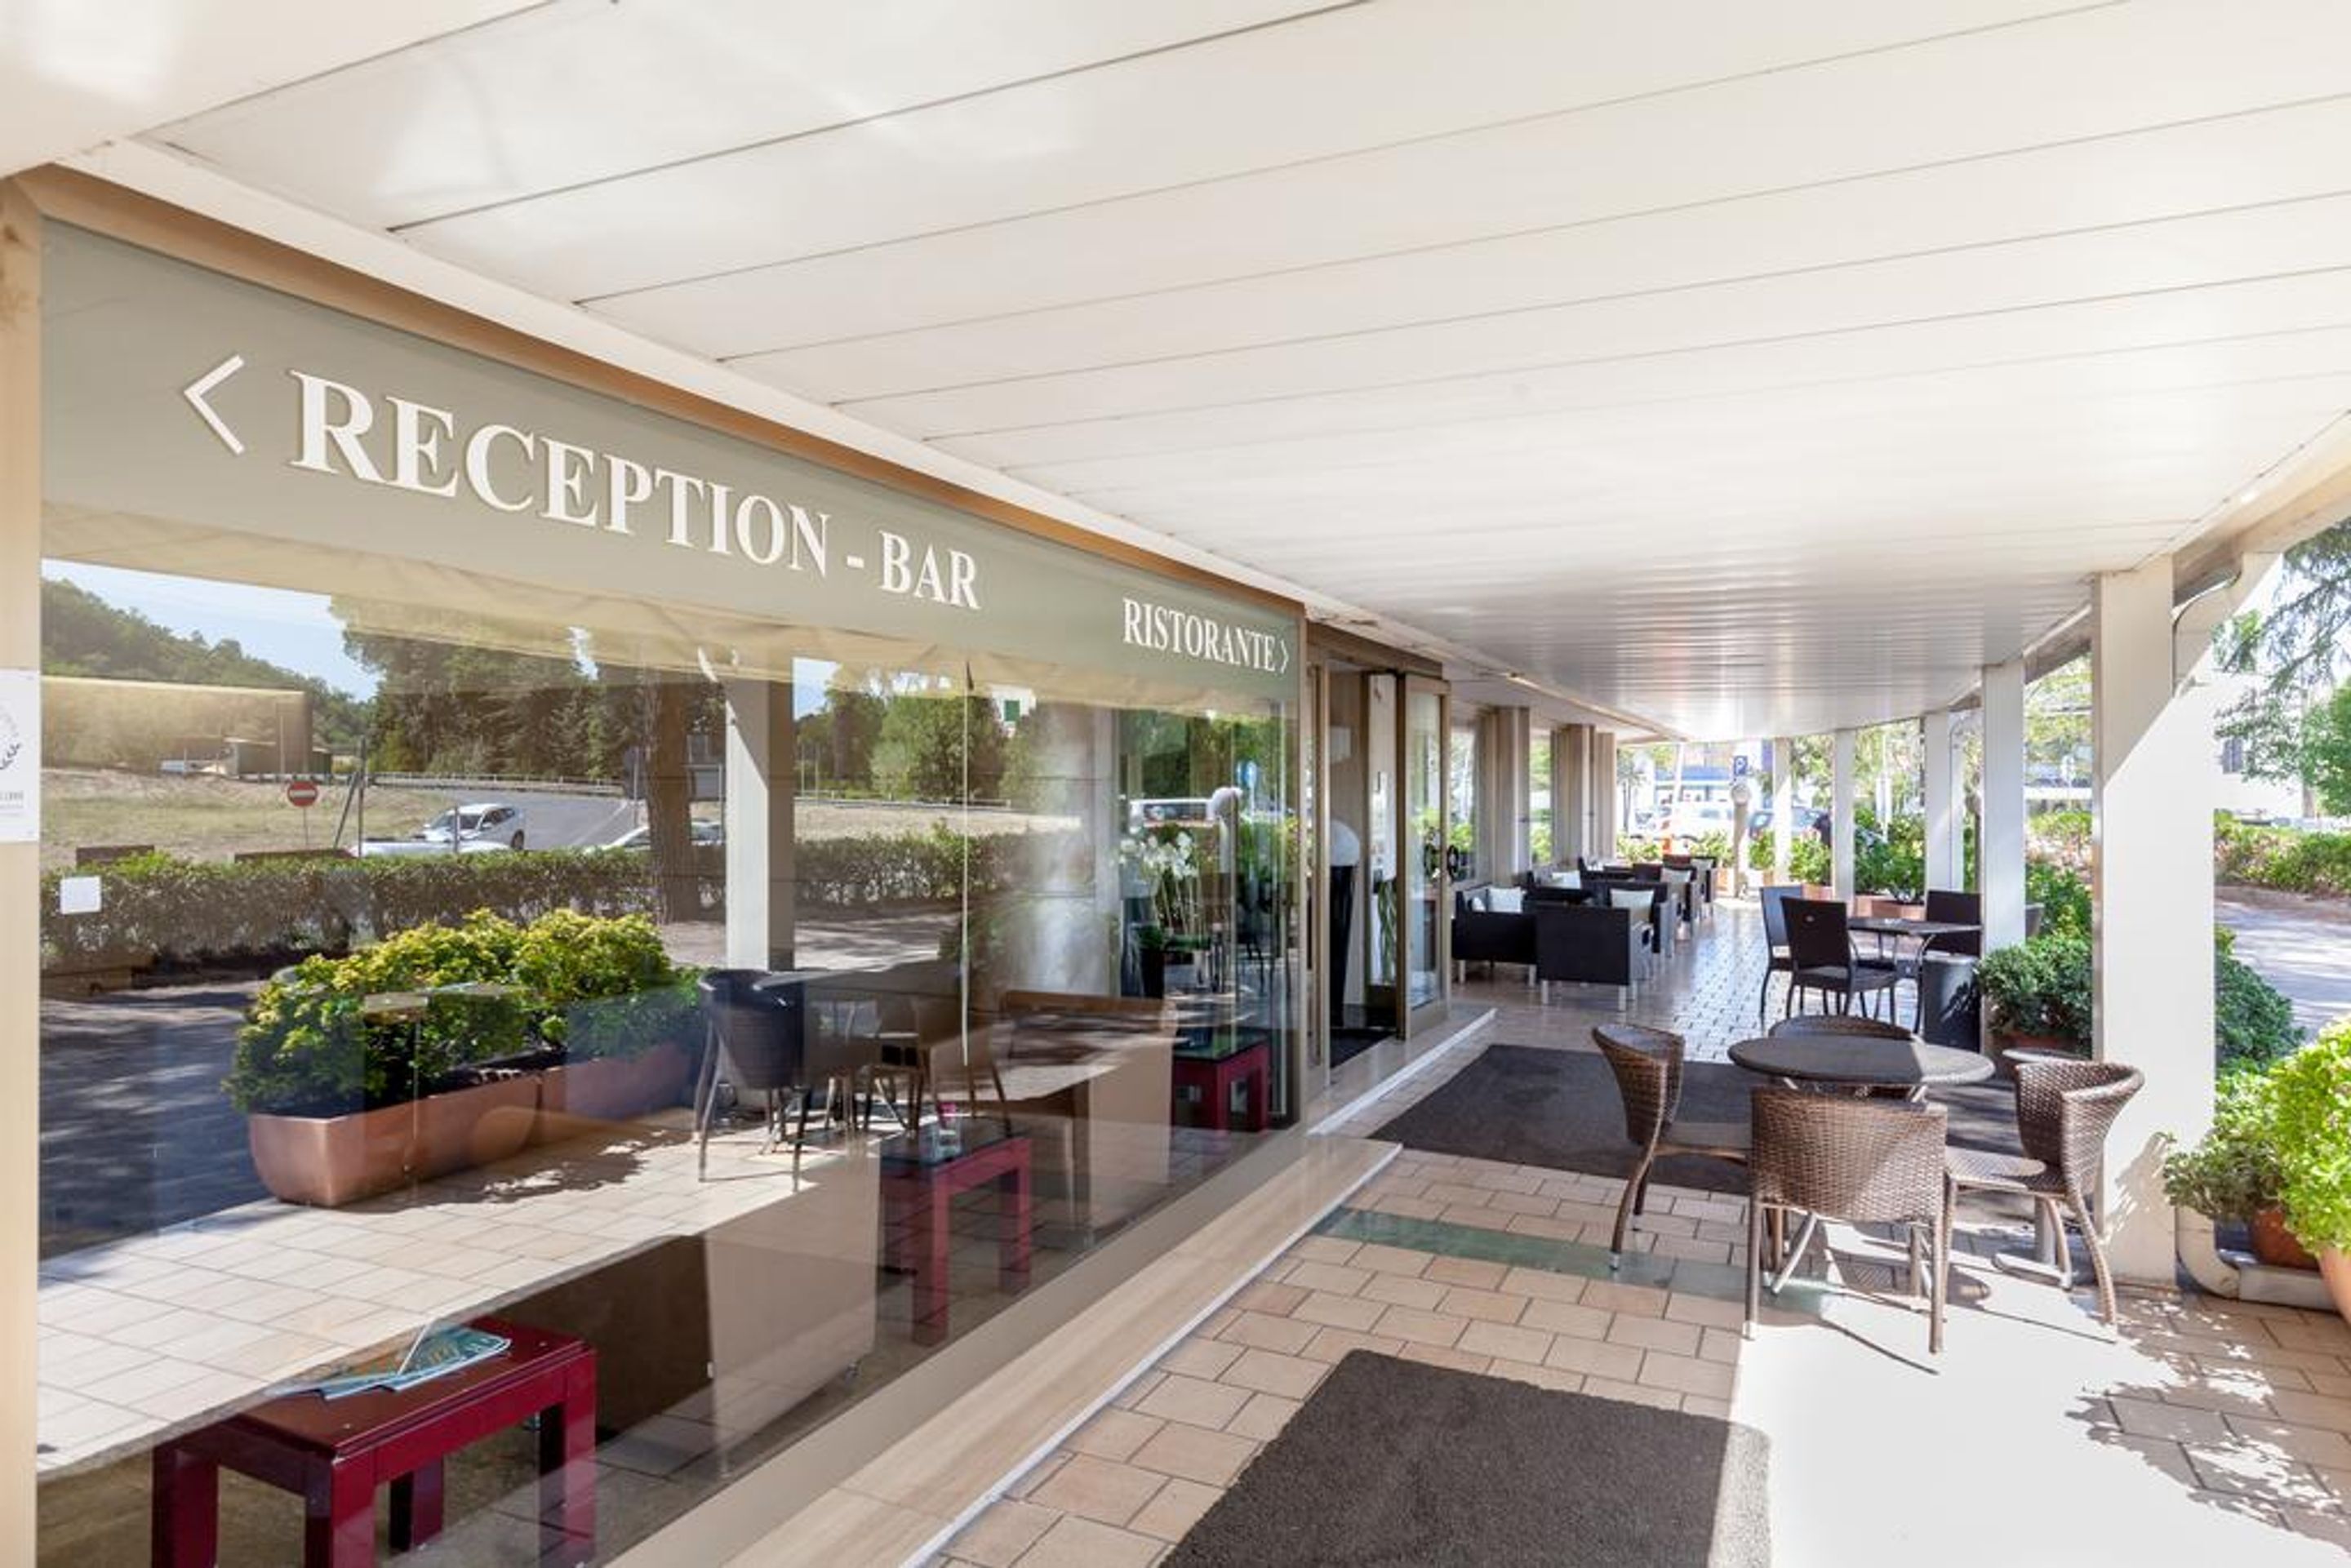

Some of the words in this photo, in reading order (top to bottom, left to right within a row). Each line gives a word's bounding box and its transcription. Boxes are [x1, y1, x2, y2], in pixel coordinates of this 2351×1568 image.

[289, 370, 830, 579] RECEPTION
[878, 531, 981, 611] BAR
[1122, 597, 1277, 672] RISTORANTE
